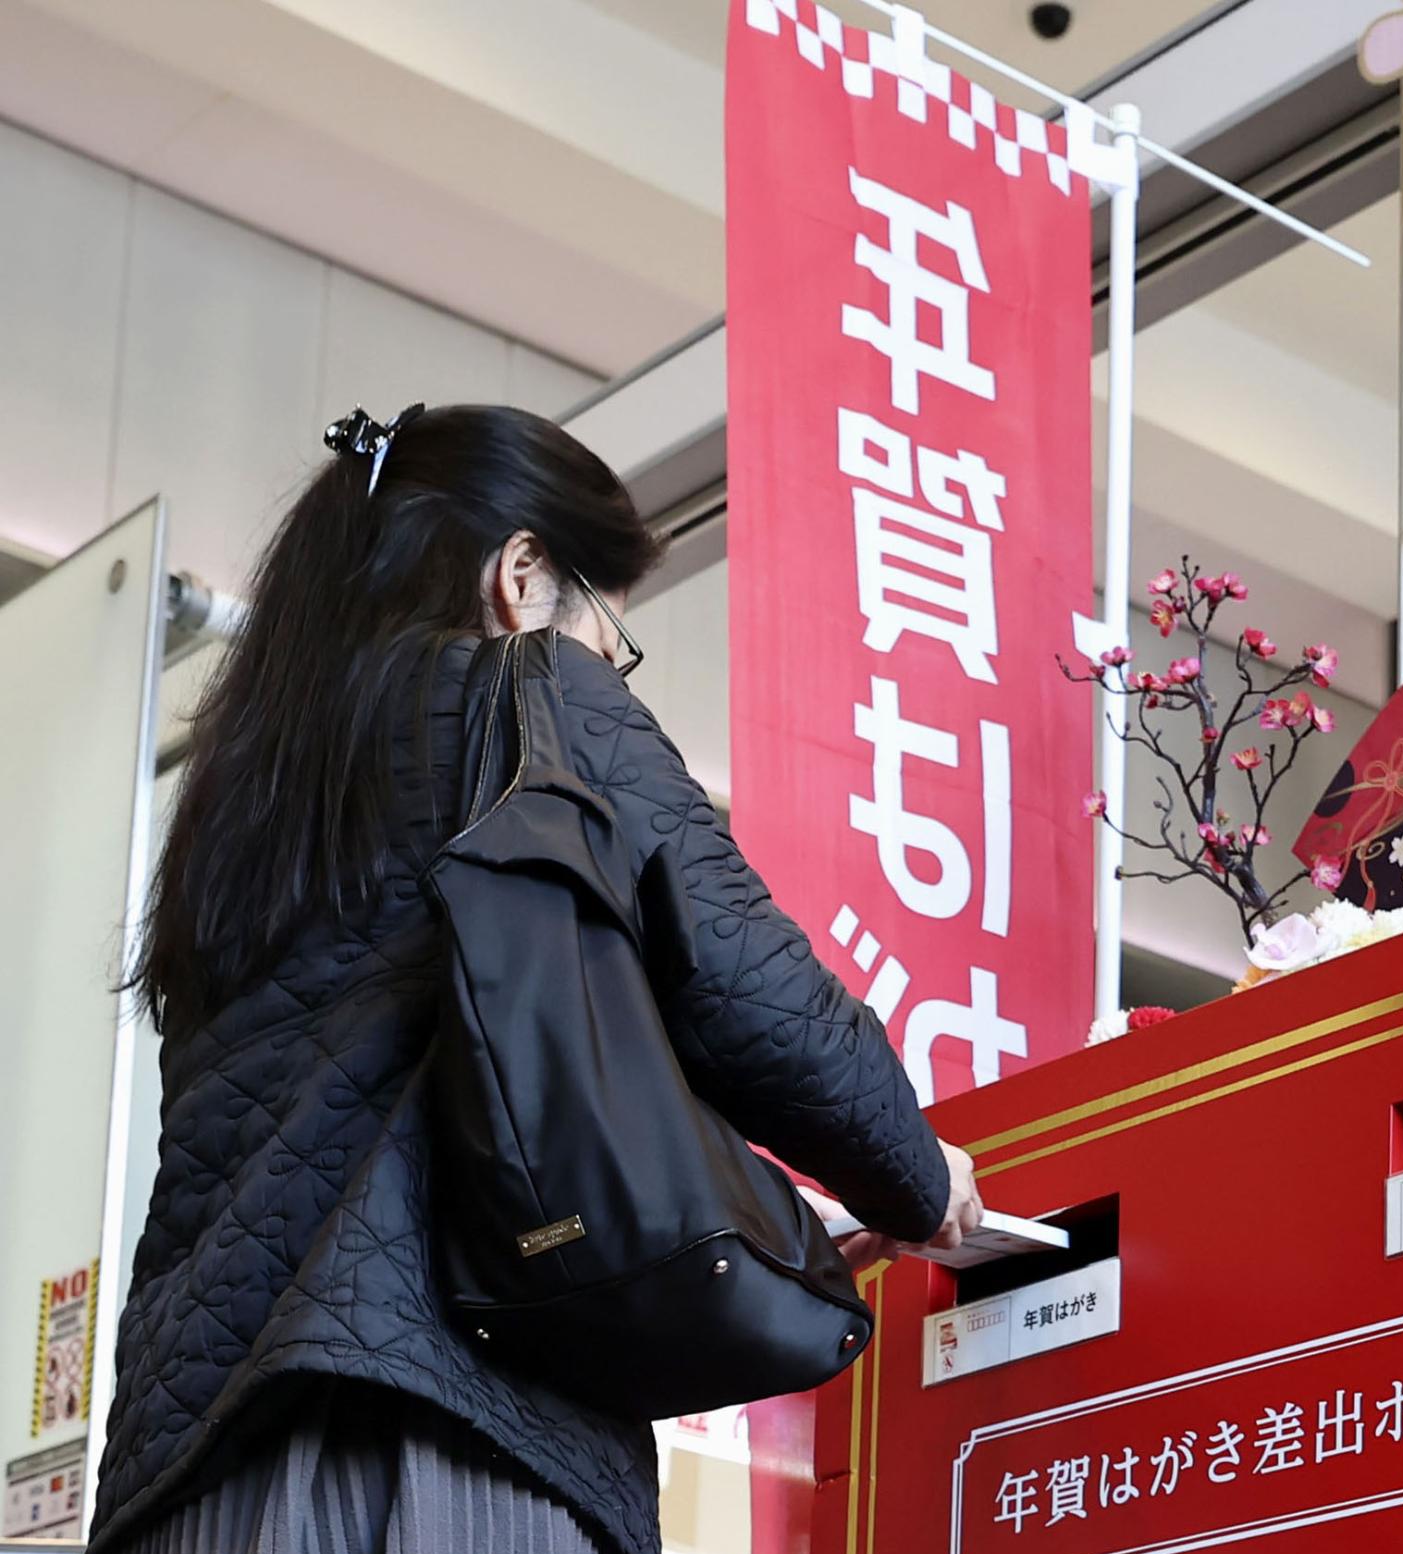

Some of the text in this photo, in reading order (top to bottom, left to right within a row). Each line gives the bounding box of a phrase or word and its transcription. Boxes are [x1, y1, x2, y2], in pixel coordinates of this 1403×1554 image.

[50, 1268, 89, 1304] NO
[1023, 1291, 1098, 1331] 年賀はがき
